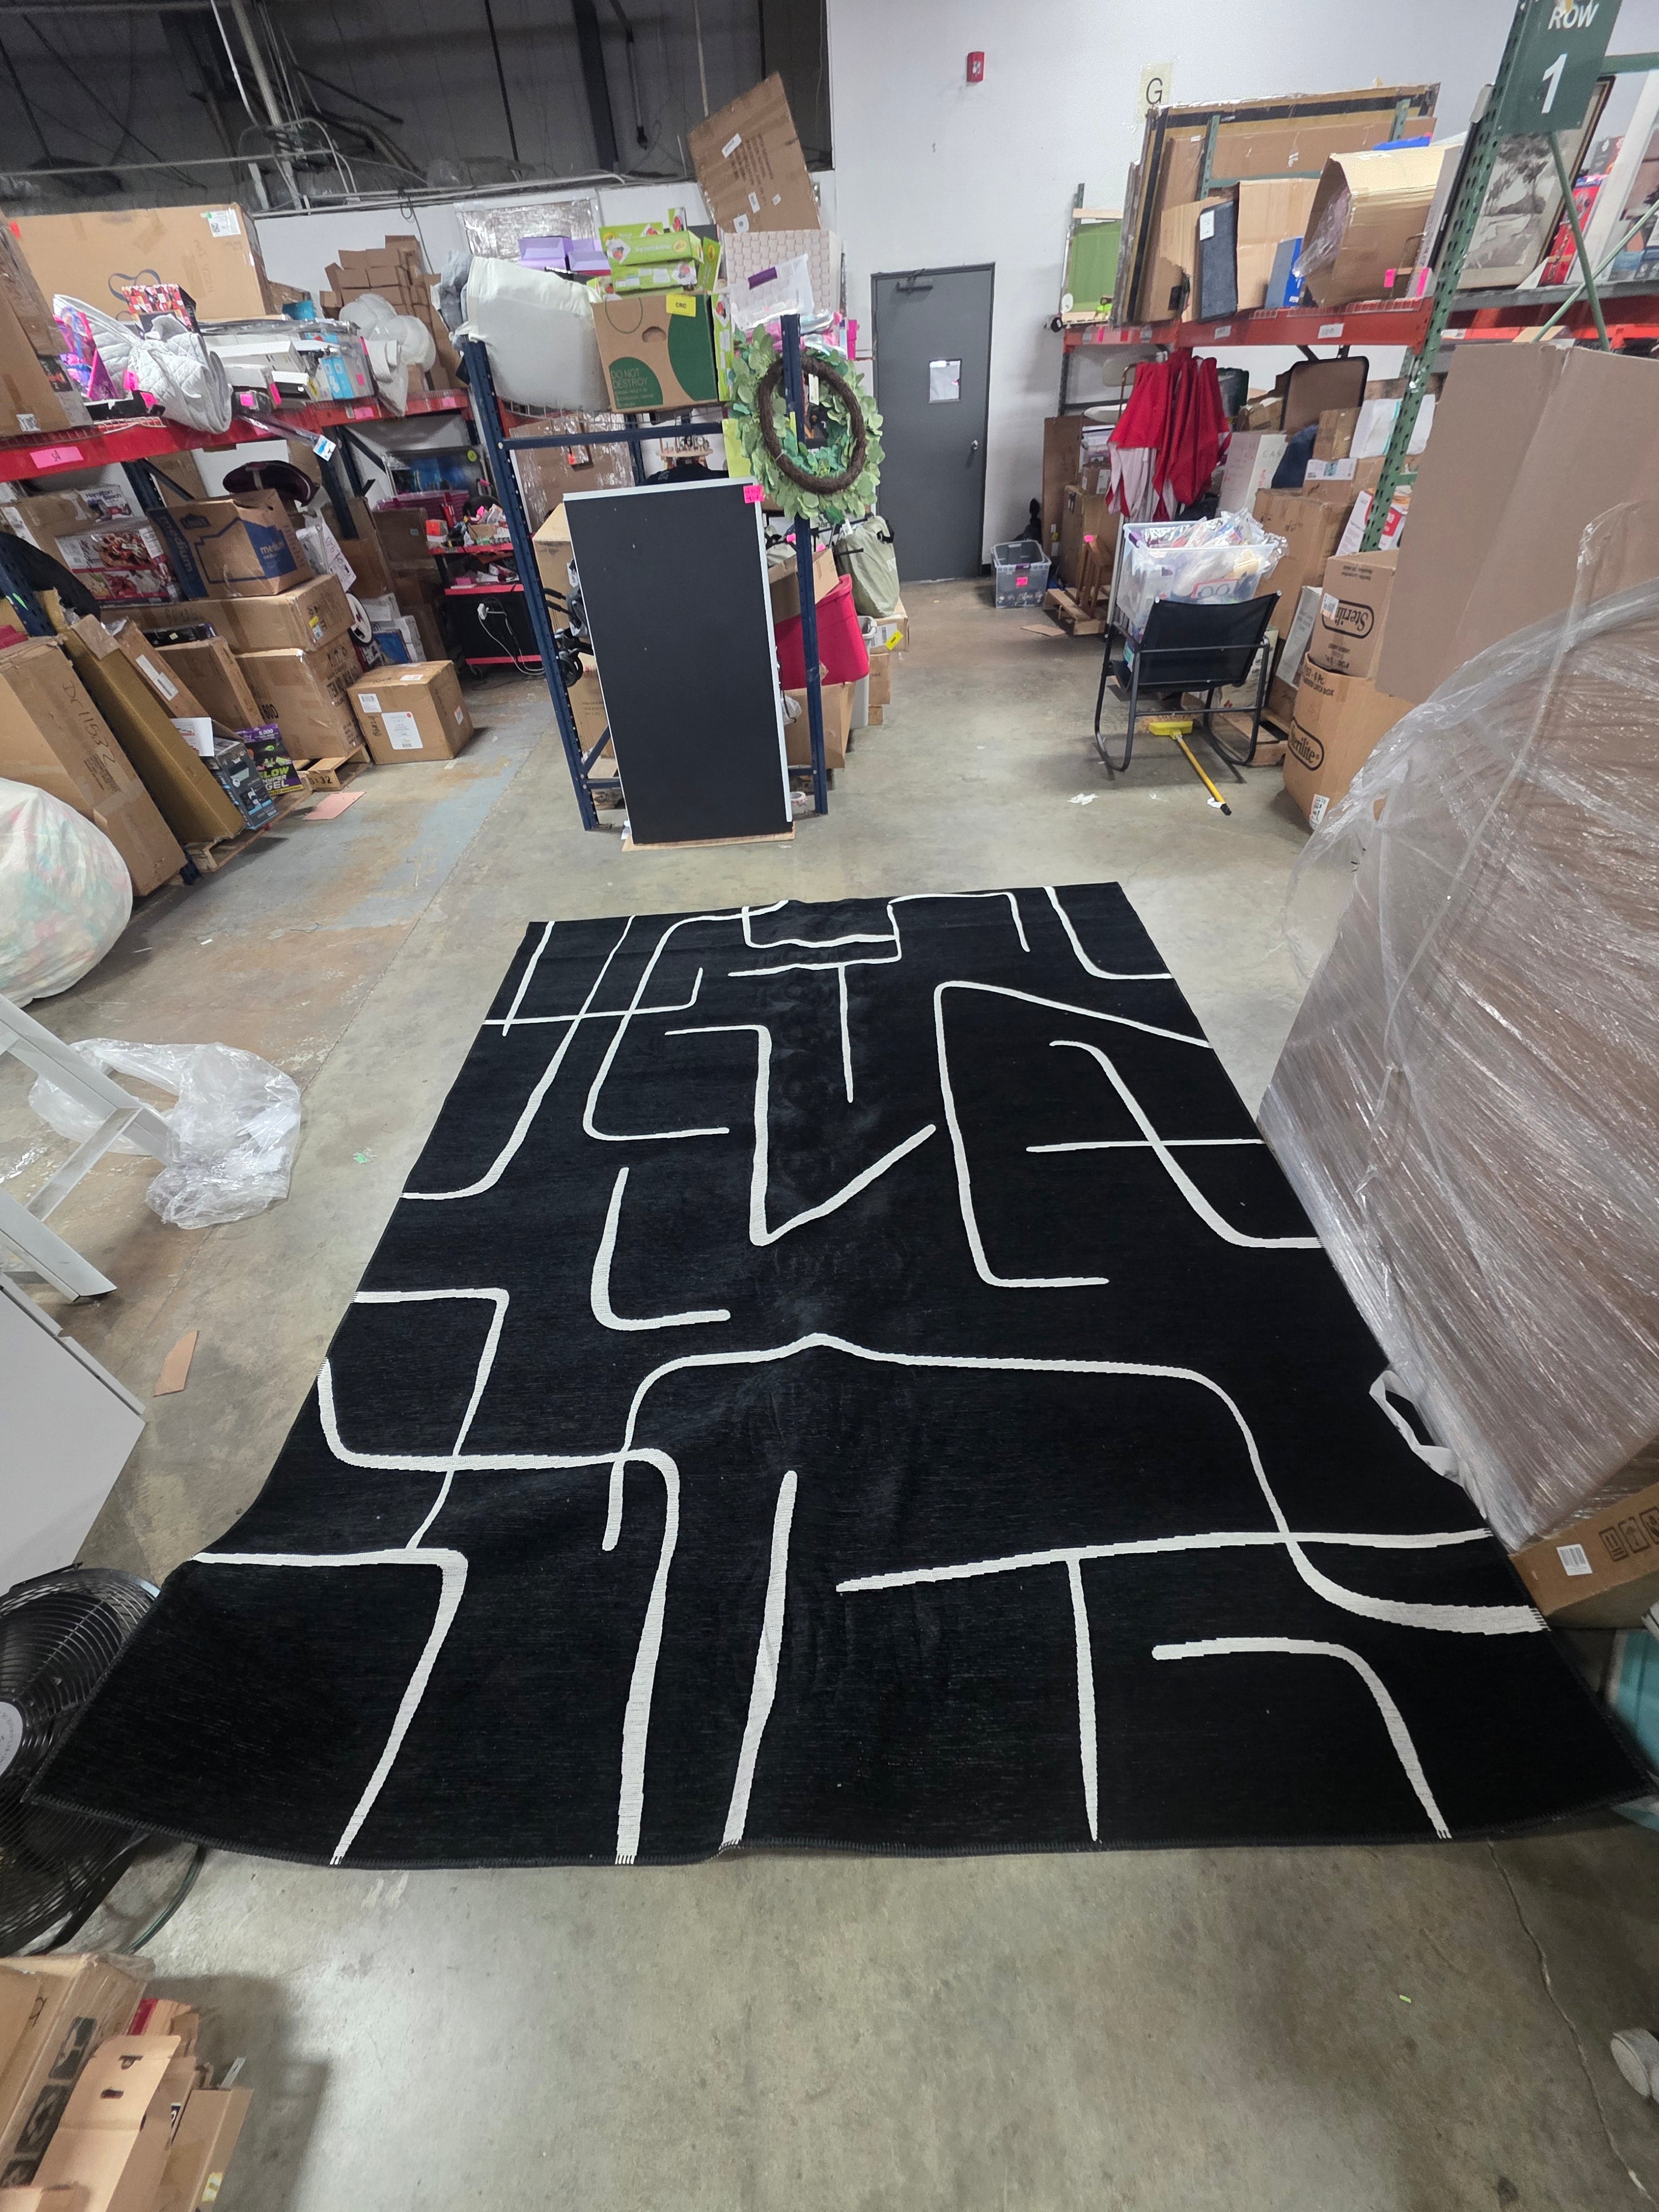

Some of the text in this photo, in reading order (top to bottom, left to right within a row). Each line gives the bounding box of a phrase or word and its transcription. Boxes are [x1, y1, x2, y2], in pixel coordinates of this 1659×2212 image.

[1548, 2, 1600, 29] ROW
[1146, 77, 1162, 105] G
[1541, 53, 1568, 114] 1
[611, 368, 640, 379] DO NOT
[613, 377, 648, 389] DESTROY
[1335, 607, 1369, 632] Sterili
[265, 779, 289, 791] GEL
